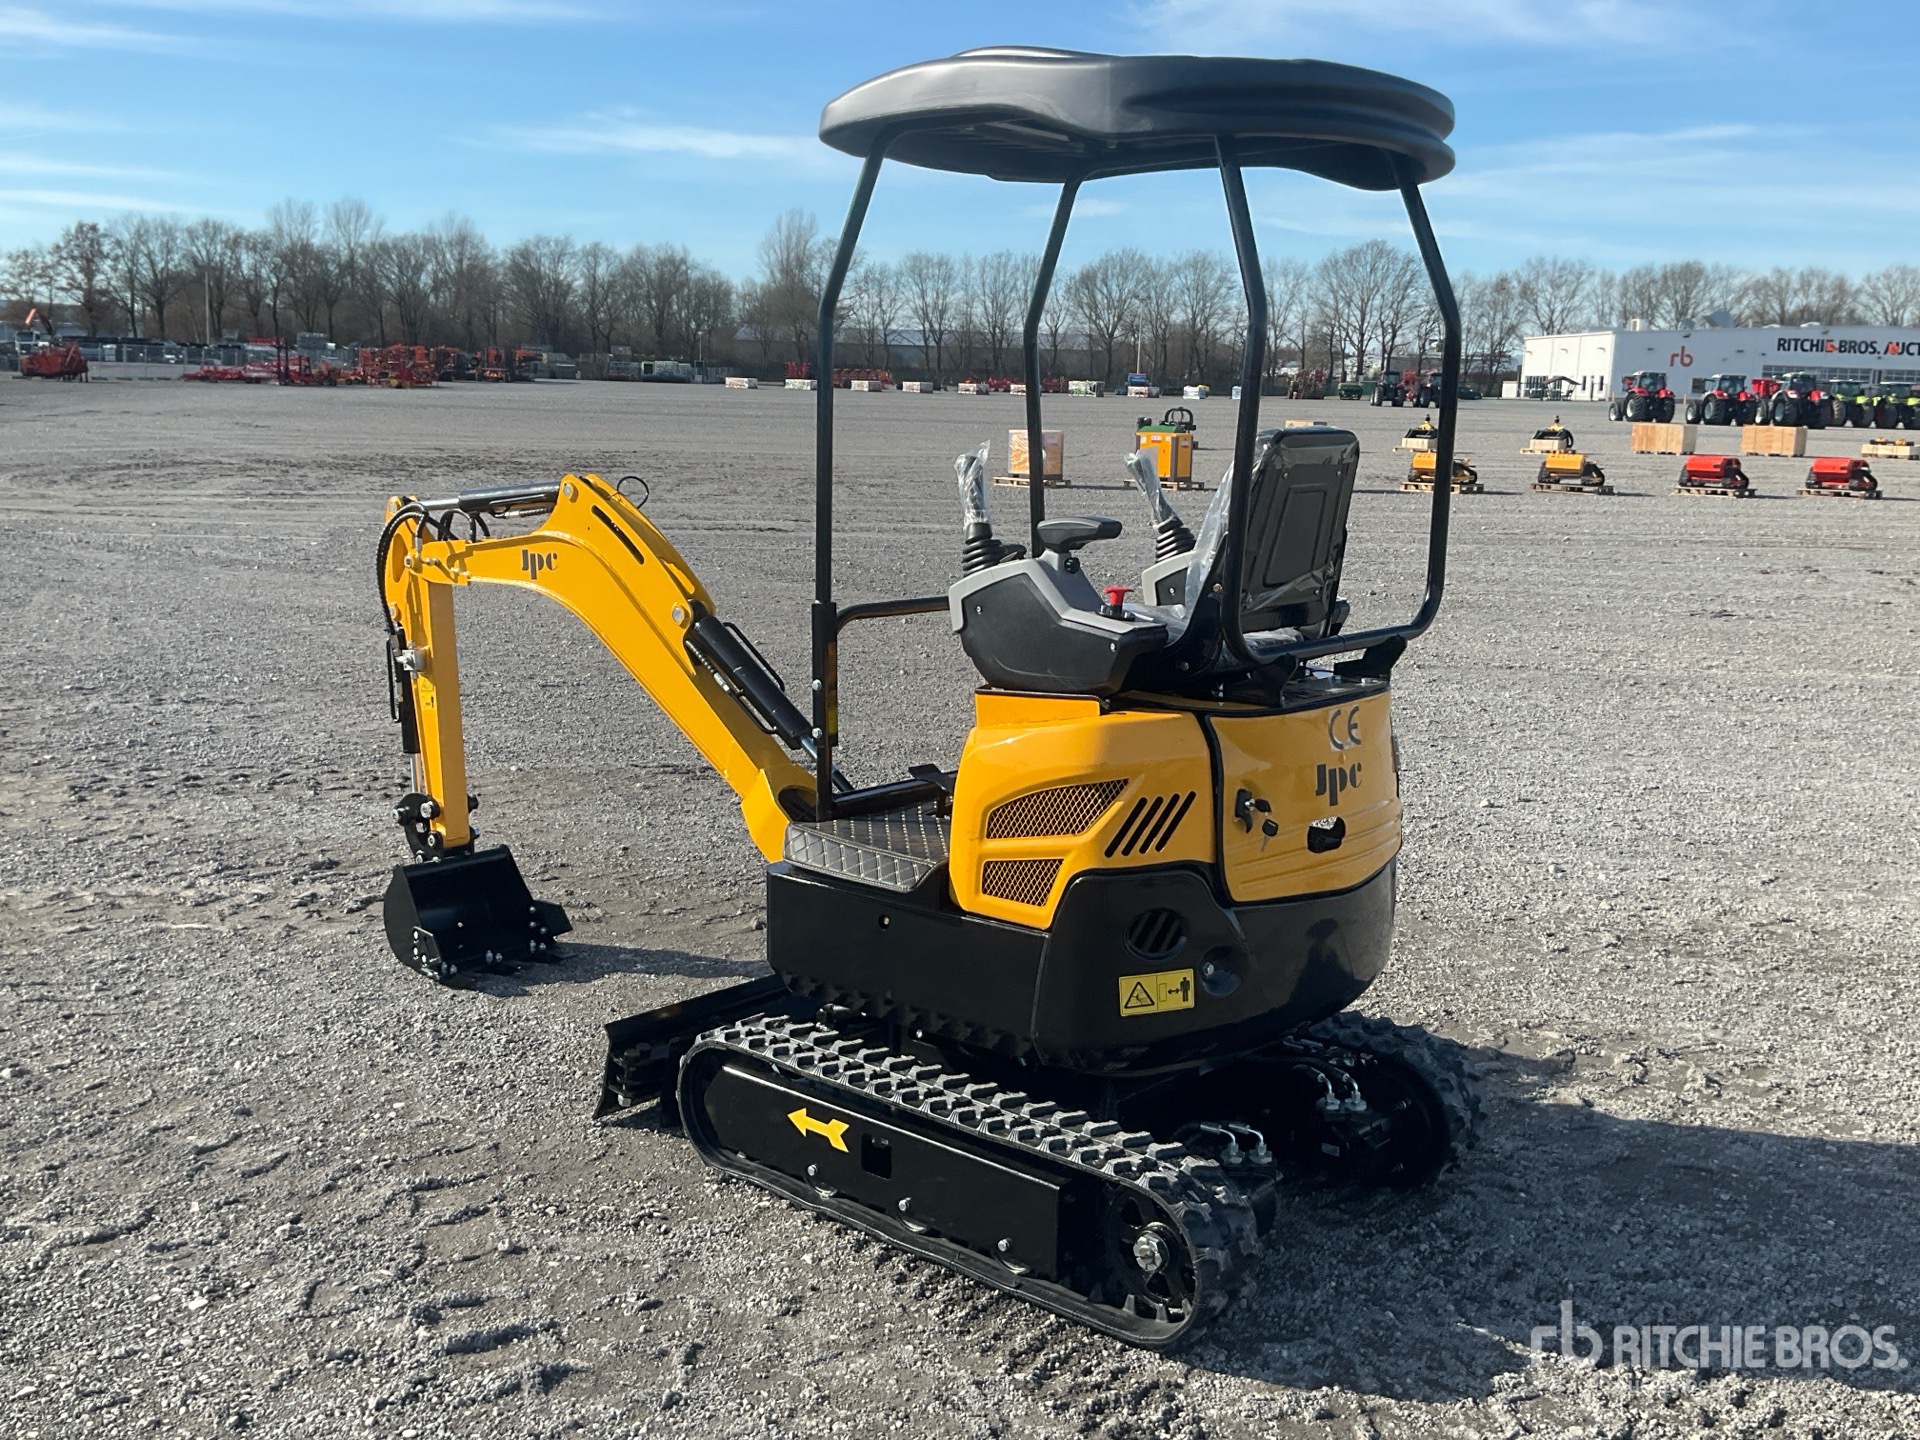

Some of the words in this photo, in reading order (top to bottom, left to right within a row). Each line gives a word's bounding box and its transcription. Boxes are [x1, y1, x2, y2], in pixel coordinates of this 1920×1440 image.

[1670, 346, 1694, 368] rb
[1777, 338, 1835, 352] RITCHIE
[1838, 340, 1880, 355] BROS.
[1328, 705, 1362, 750] CE
